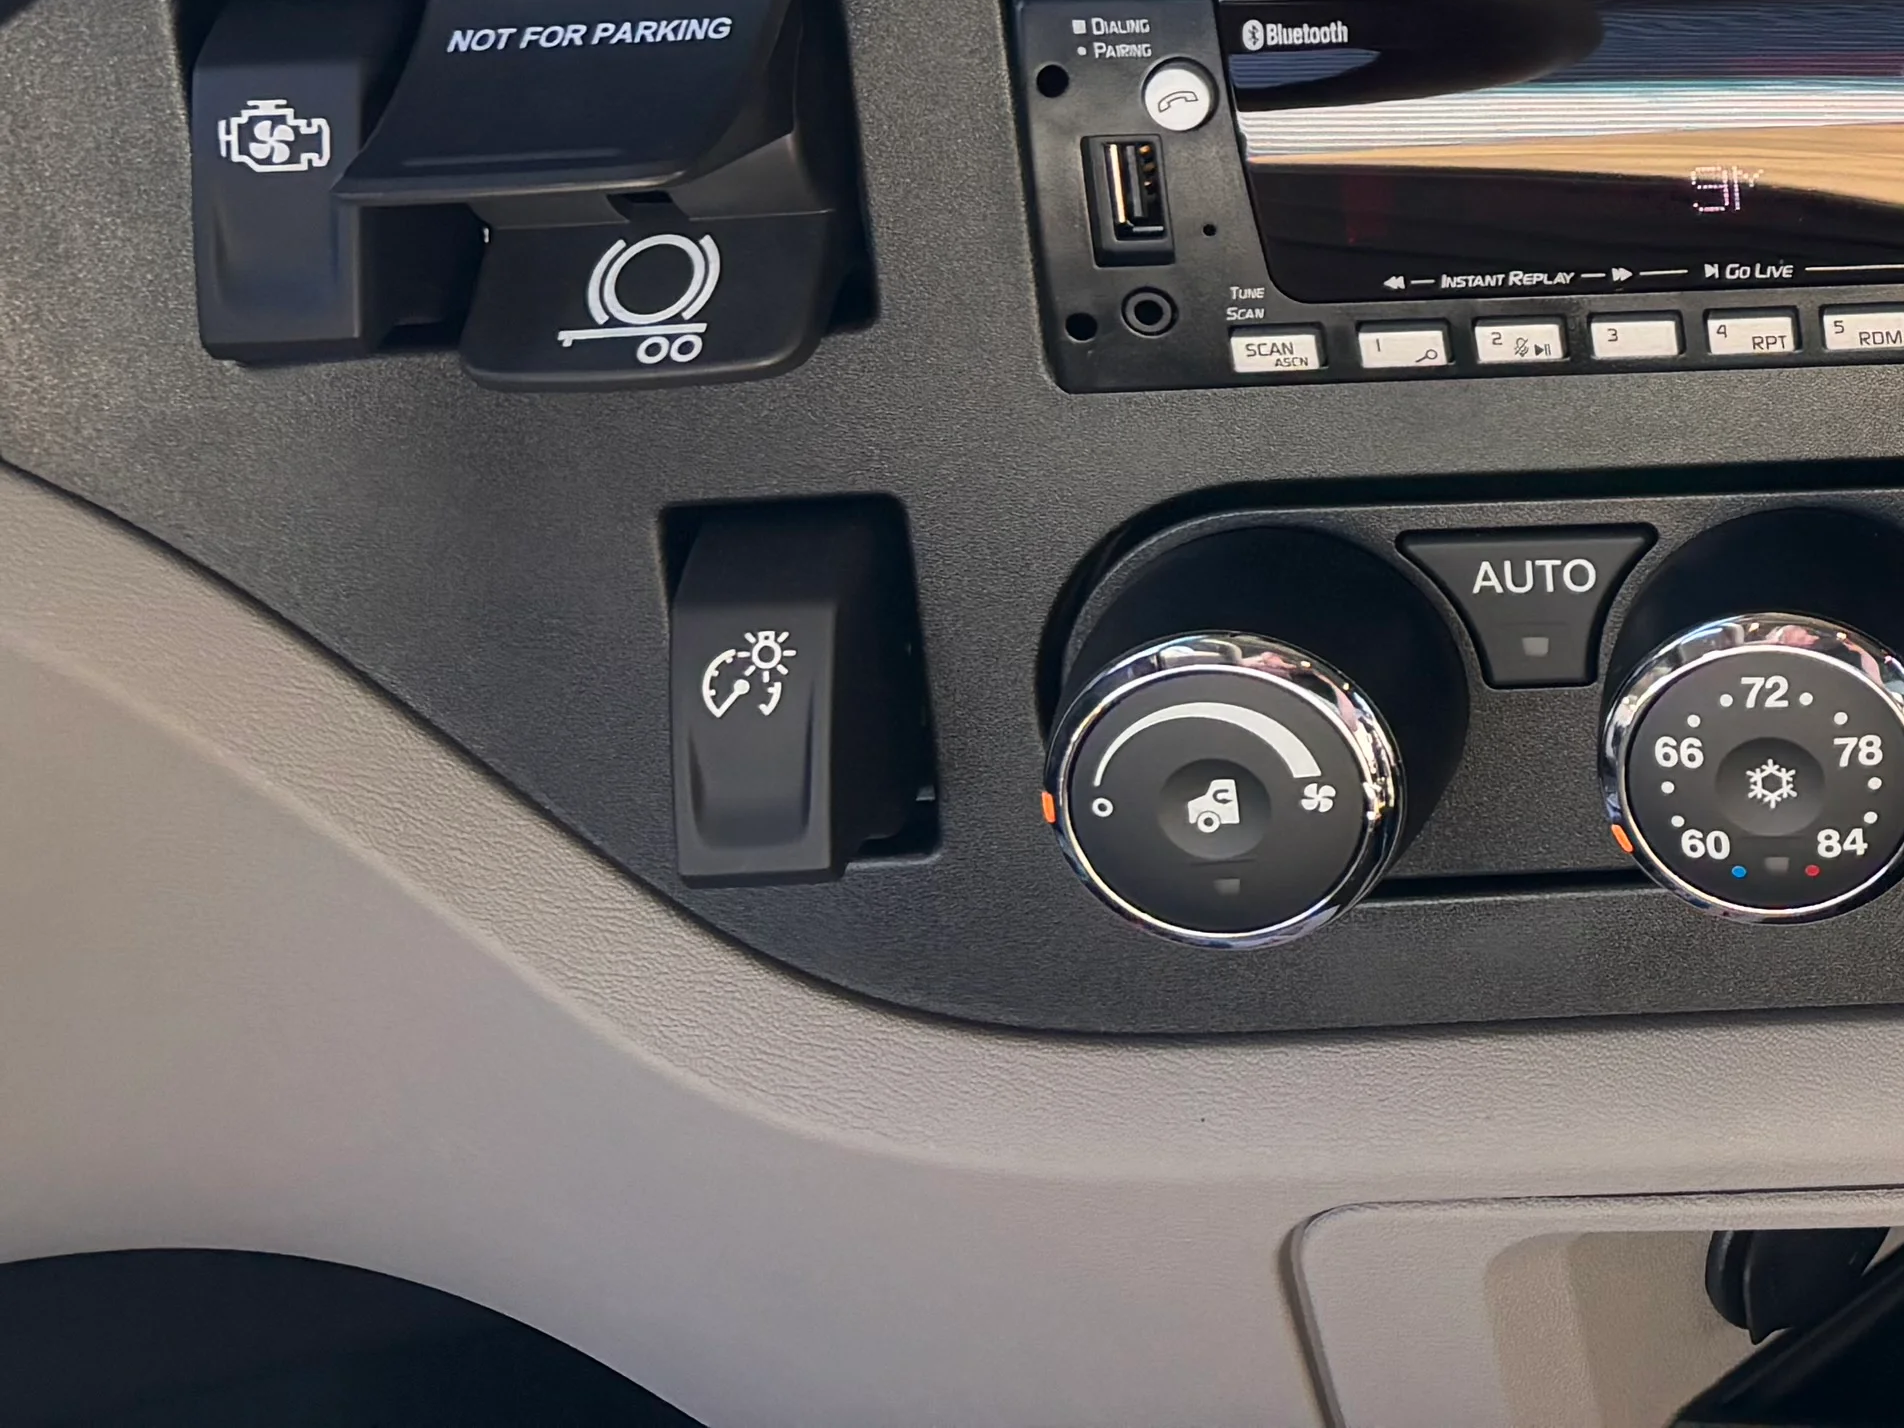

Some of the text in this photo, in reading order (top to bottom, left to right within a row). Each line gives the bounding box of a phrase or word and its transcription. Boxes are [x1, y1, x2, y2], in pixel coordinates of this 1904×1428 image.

[446, 17, 732, 52] NOT FOR PARKING
[1266, 21, 1348, 46] Bluetooth
[1607, 328, 1619, 342] 3
[1716, 324, 1728, 339] 4
[1833, 320, 1845, 334] 5
[1245, 340, 1294, 357] SCAN
[1491, 332, 1502, 346] 2
[1752, 335, 1788, 351] RPT
[1859, 330, 1903, 346] RDM
[1274, 356, 1309, 367] ASCN
[1472, 558, 1598, 596] AUTO
[1740, 675, 1790, 709] 72
[1654, 736, 1705, 769] 66
[1833, 734, 1883, 768] 78
[1681, 830, 1731, 860] 60
[1816, 828, 1868, 858] 84
